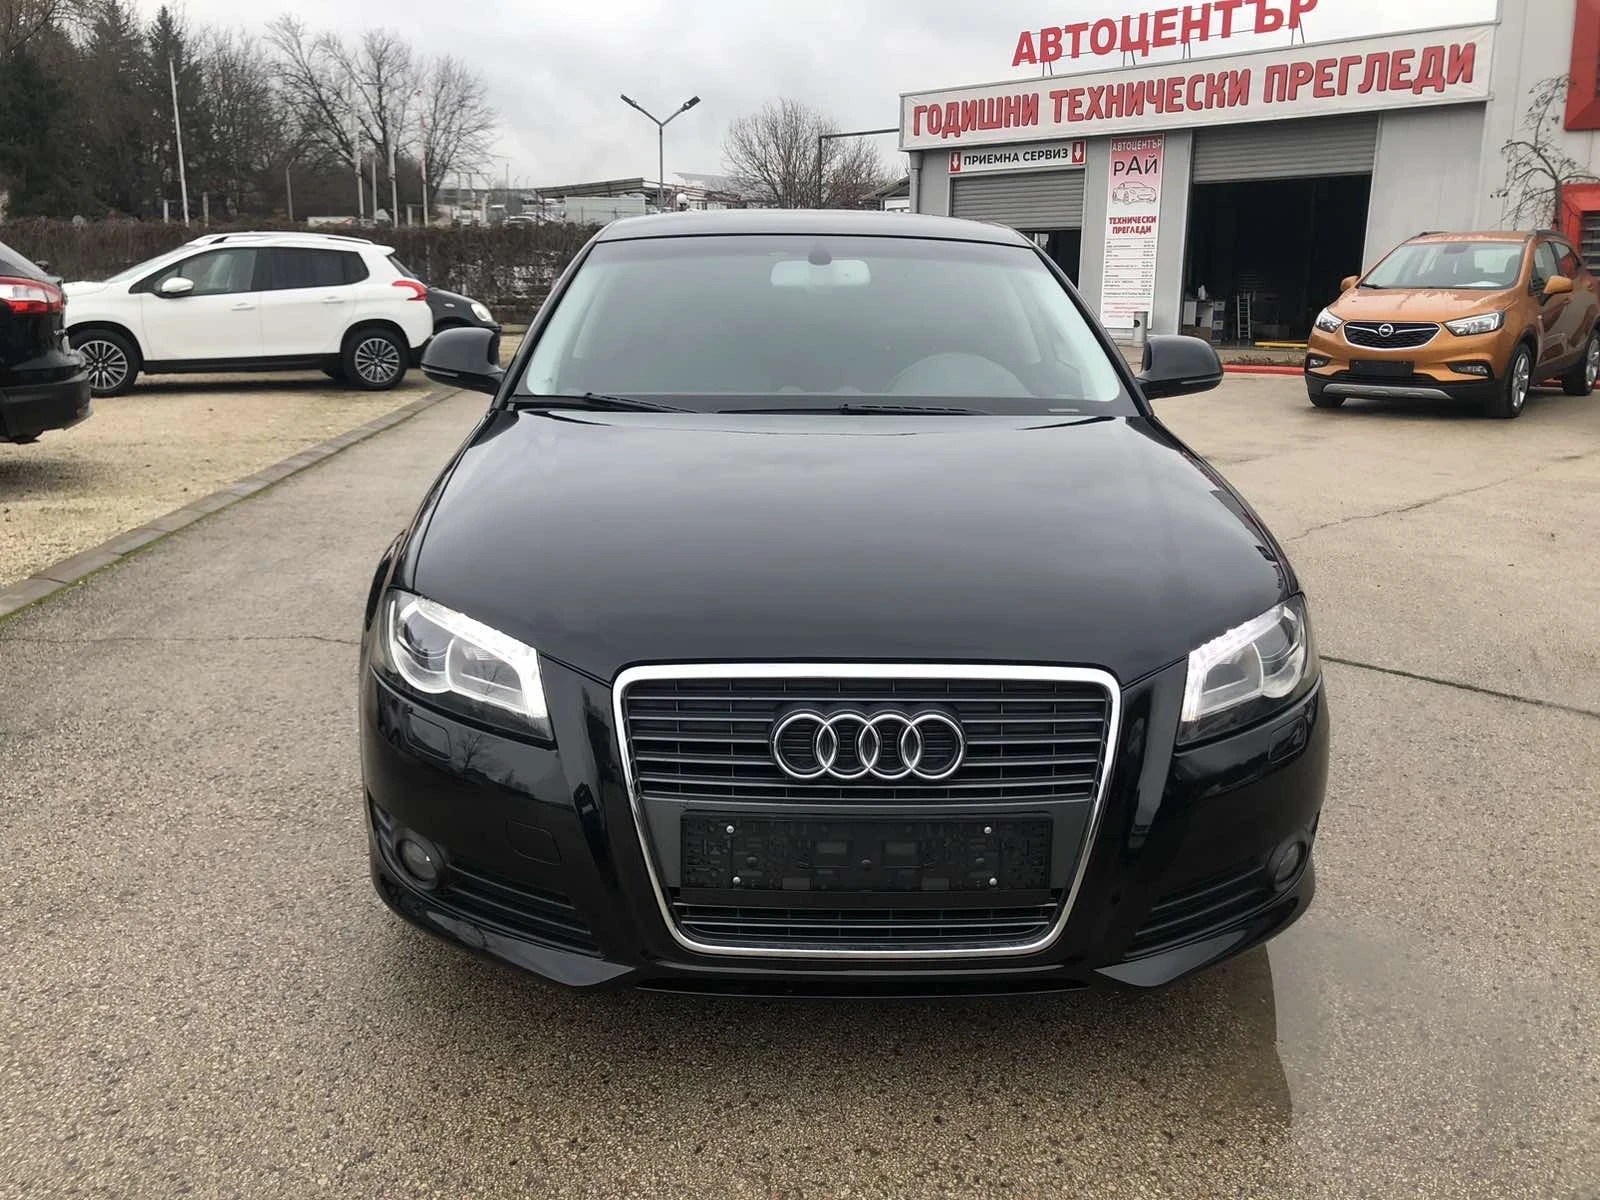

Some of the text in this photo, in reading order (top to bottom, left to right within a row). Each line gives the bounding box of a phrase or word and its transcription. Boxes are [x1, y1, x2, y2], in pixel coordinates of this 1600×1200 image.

[1012, 0, 1318, 66] АВТОЦЕНТЪР
[913, 42, 1476, 138] ГОДИШНИ ТЕХНИЧЕСКИ ПРЕГЛЕДИ
[1112, 139, 1162, 152] АВТОЦЕНТЪР
[963, 148, 1069, 166] ПРИЕМНА СЕРВИЗ
[1108, 216, 1157, 225] ТЕХНИЧЕСКИ
[1112, 225, 1152, 235] ПРЕГЛЕДИ
